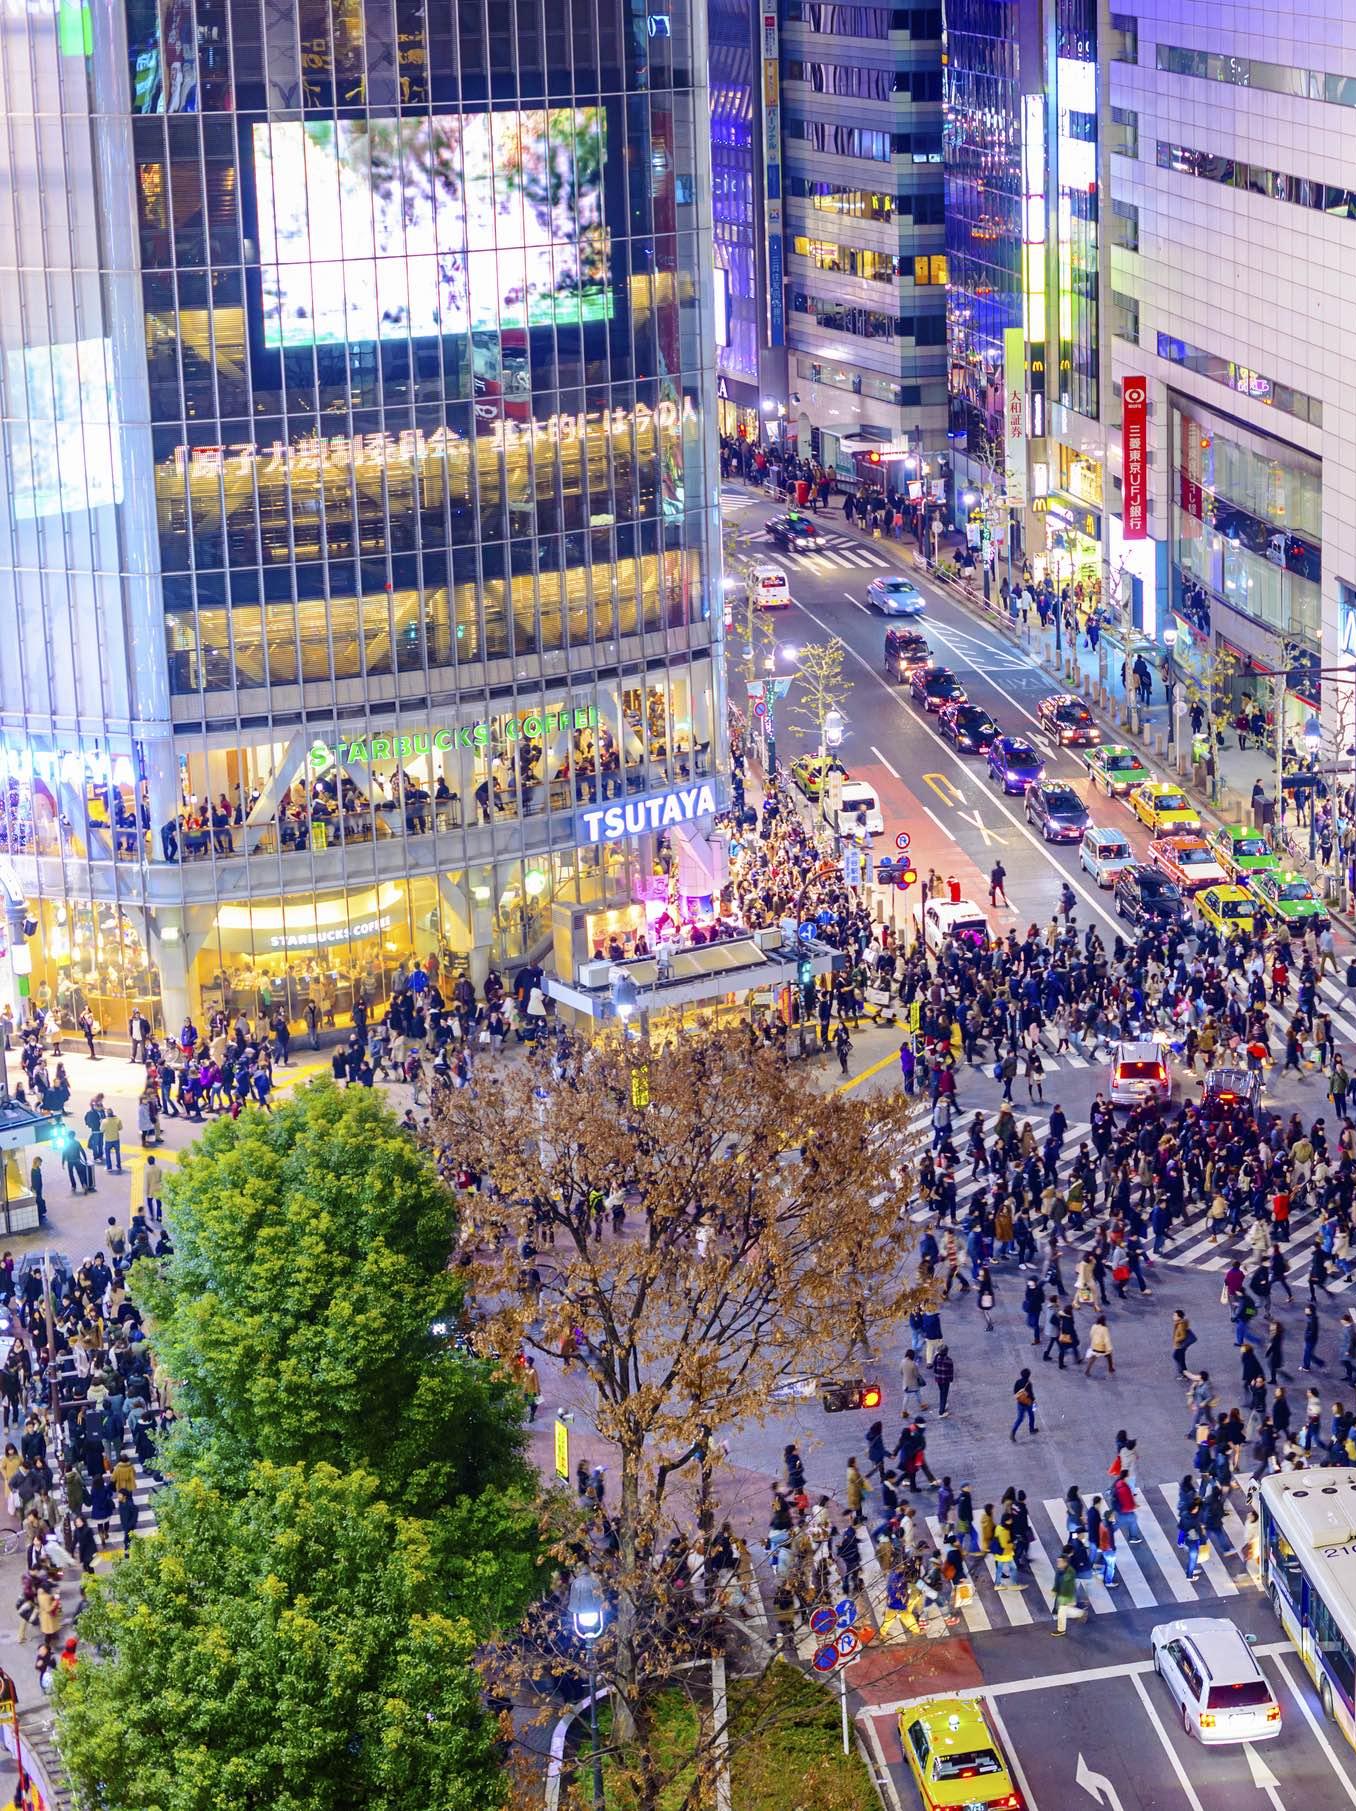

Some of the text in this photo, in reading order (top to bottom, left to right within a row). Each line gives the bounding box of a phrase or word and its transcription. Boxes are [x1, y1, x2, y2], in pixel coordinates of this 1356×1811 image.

[1010, 389, 1022, 438] 大和証券
[1129, 425, 1142, 530] 三菱東京UFJ銀行
[310, 723, 490, 769] STARBUCKS
[584, 786, 717, 843] TSUTAYA
[271, 916, 391, 947] STARBUCKS COFFEE
